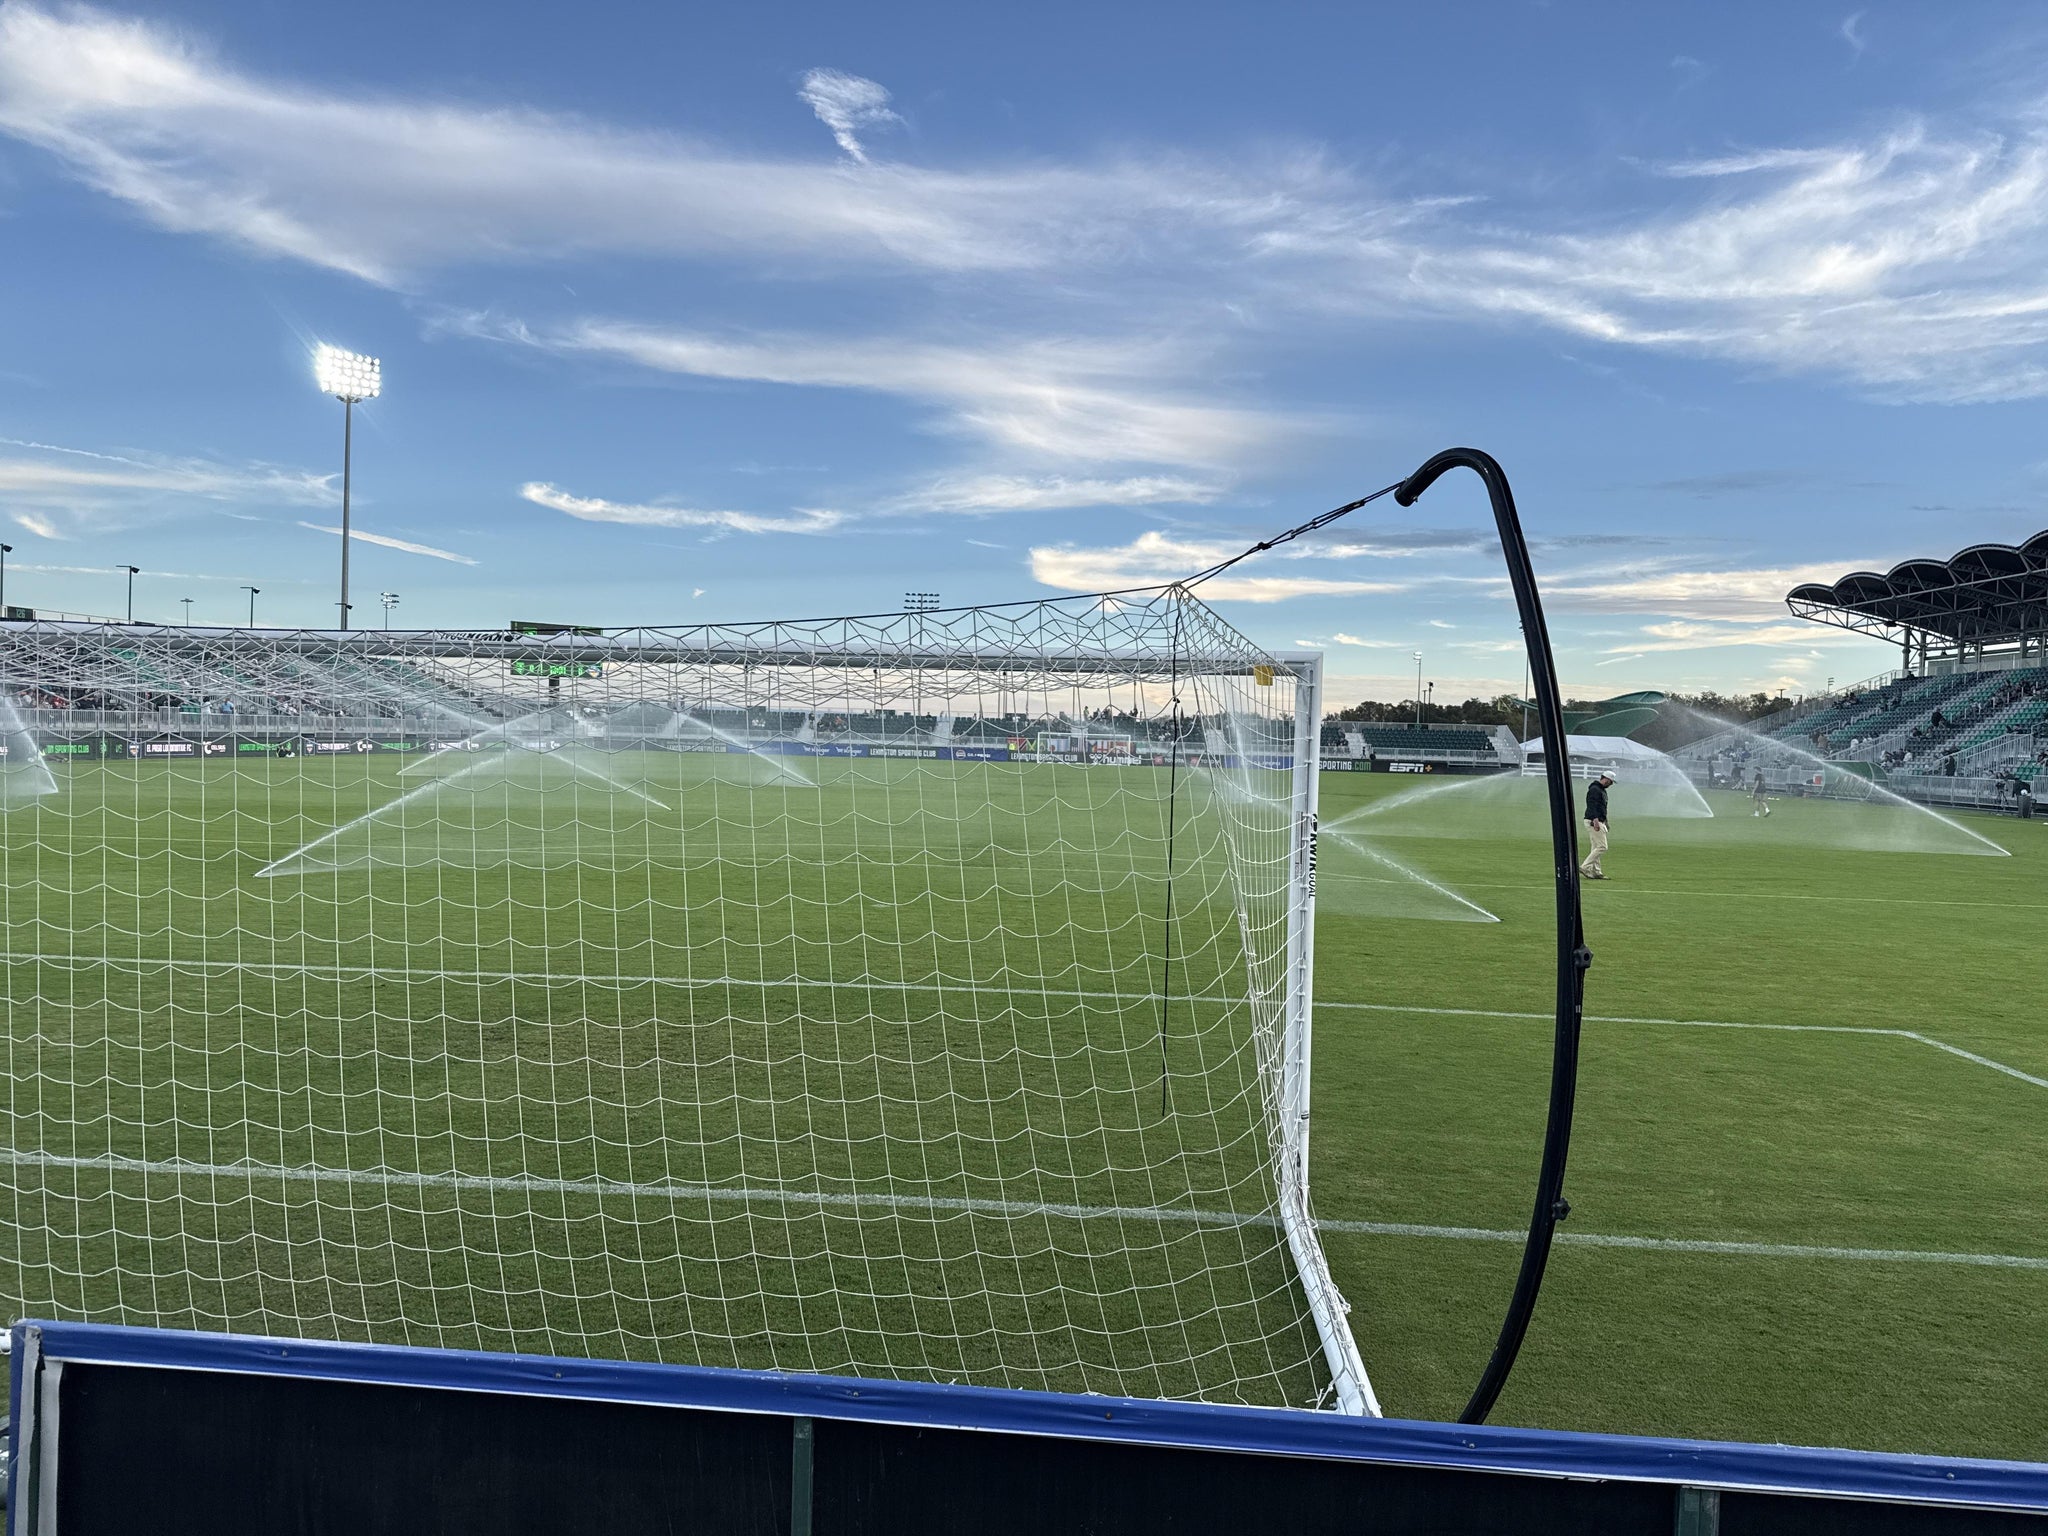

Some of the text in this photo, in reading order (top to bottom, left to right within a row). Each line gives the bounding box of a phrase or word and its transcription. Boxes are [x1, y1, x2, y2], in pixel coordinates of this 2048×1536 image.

[78, 745, 90, 753] CLUB
[870, 748, 896, 756] LEXINGTON
[1011, 753, 1038, 761] LEXINGTON
[1103, 753, 1142, 764] hummel
[1308, 832, 1318, 899] KWIKGOAL
